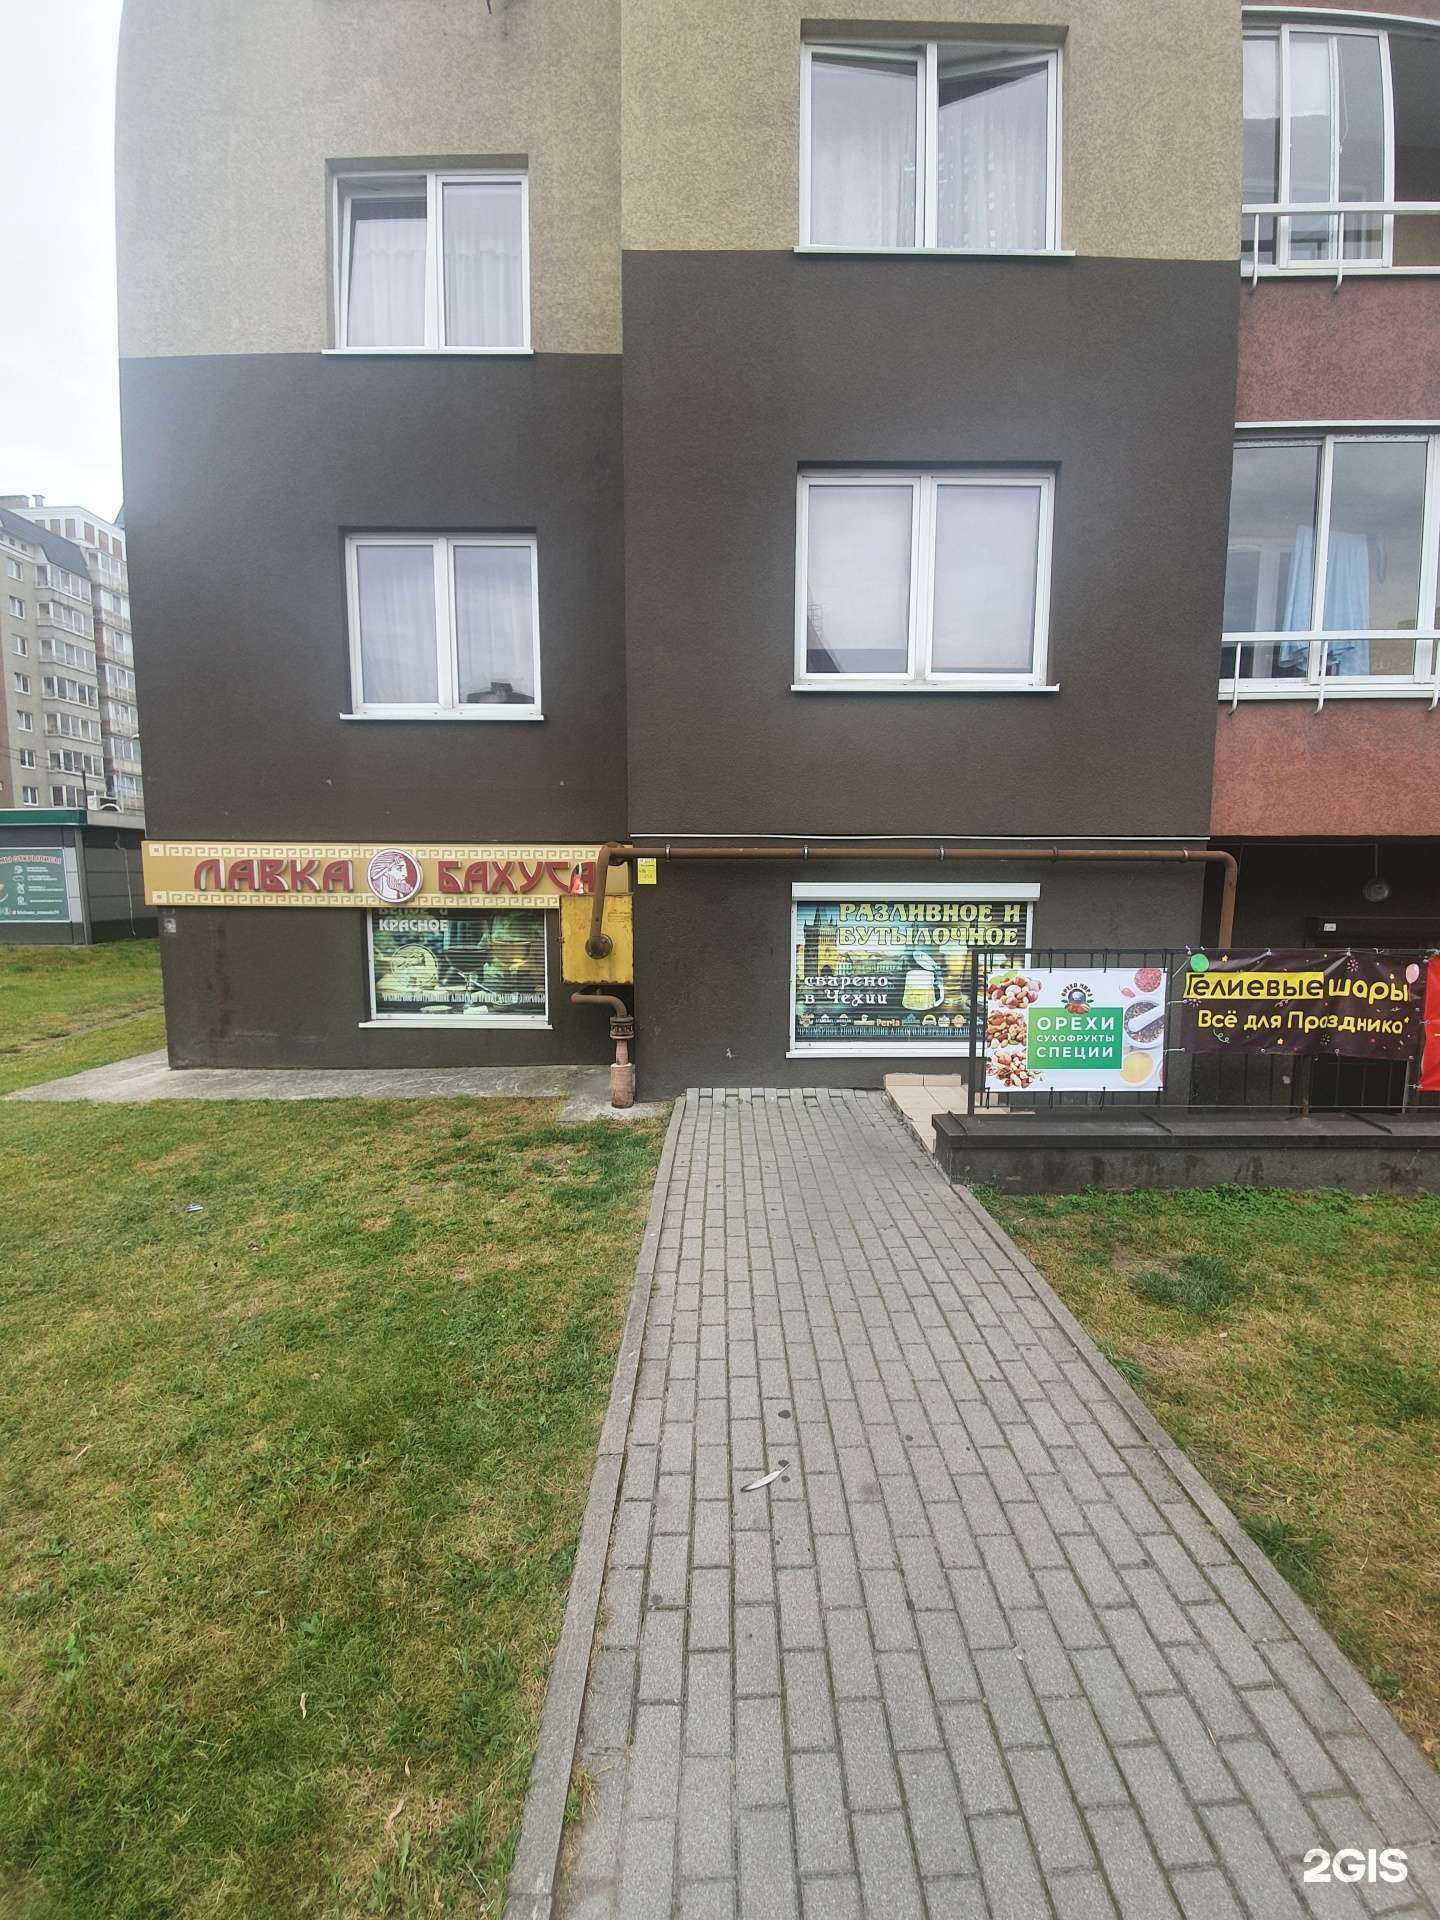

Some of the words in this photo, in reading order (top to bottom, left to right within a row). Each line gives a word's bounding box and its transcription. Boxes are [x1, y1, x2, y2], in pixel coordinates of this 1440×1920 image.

[194, 858, 353, 892] ЛАВКА
[438, 860, 596, 894] БАХУСА
[839, 903, 993, 922] РАЗЛИВНОЕ
[1004, 904, 1020, 923] И
[379, 919, 449, 932] КРАСНОЕ
[838, 927, 1018, 946] БУТЫЛОЧНОЕ
[804, 976, 888, 988] сварено
[1187, 974, 1323, 997] Гелиевые
[1328, 978, 1408, 1004] шары
[804, 993, 815, 1004] в
[824, 989, 887, 1006] Чехии
[1037, 1017, 1114, 1030] ОРЕХИ
[1198, 1010, 1237, 1028] Всё
[1244, 1014, 1281, 1031] для
[1036, 1047, 1113, 1059] СПЕЦИИ
